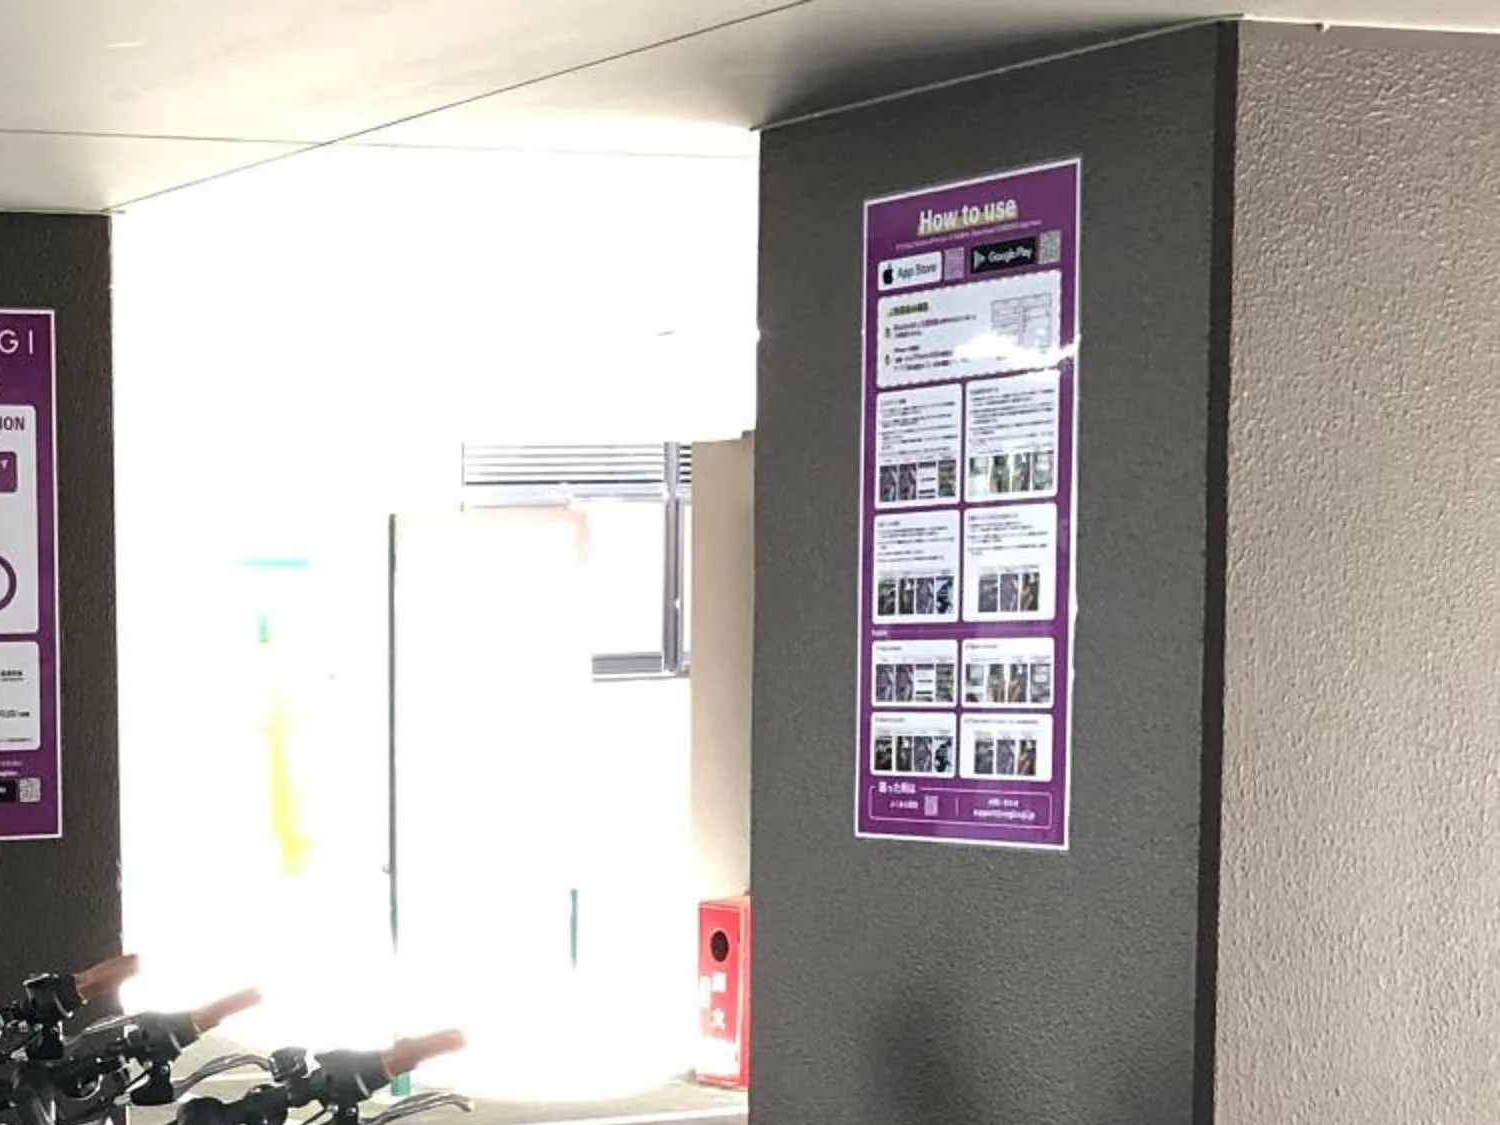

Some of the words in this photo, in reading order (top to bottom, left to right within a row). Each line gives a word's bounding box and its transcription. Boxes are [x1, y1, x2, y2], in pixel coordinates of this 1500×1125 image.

[920, 208, 957, 231] How
[961, 204, 982, 224] to
[984, 199, 1017, 219] use
